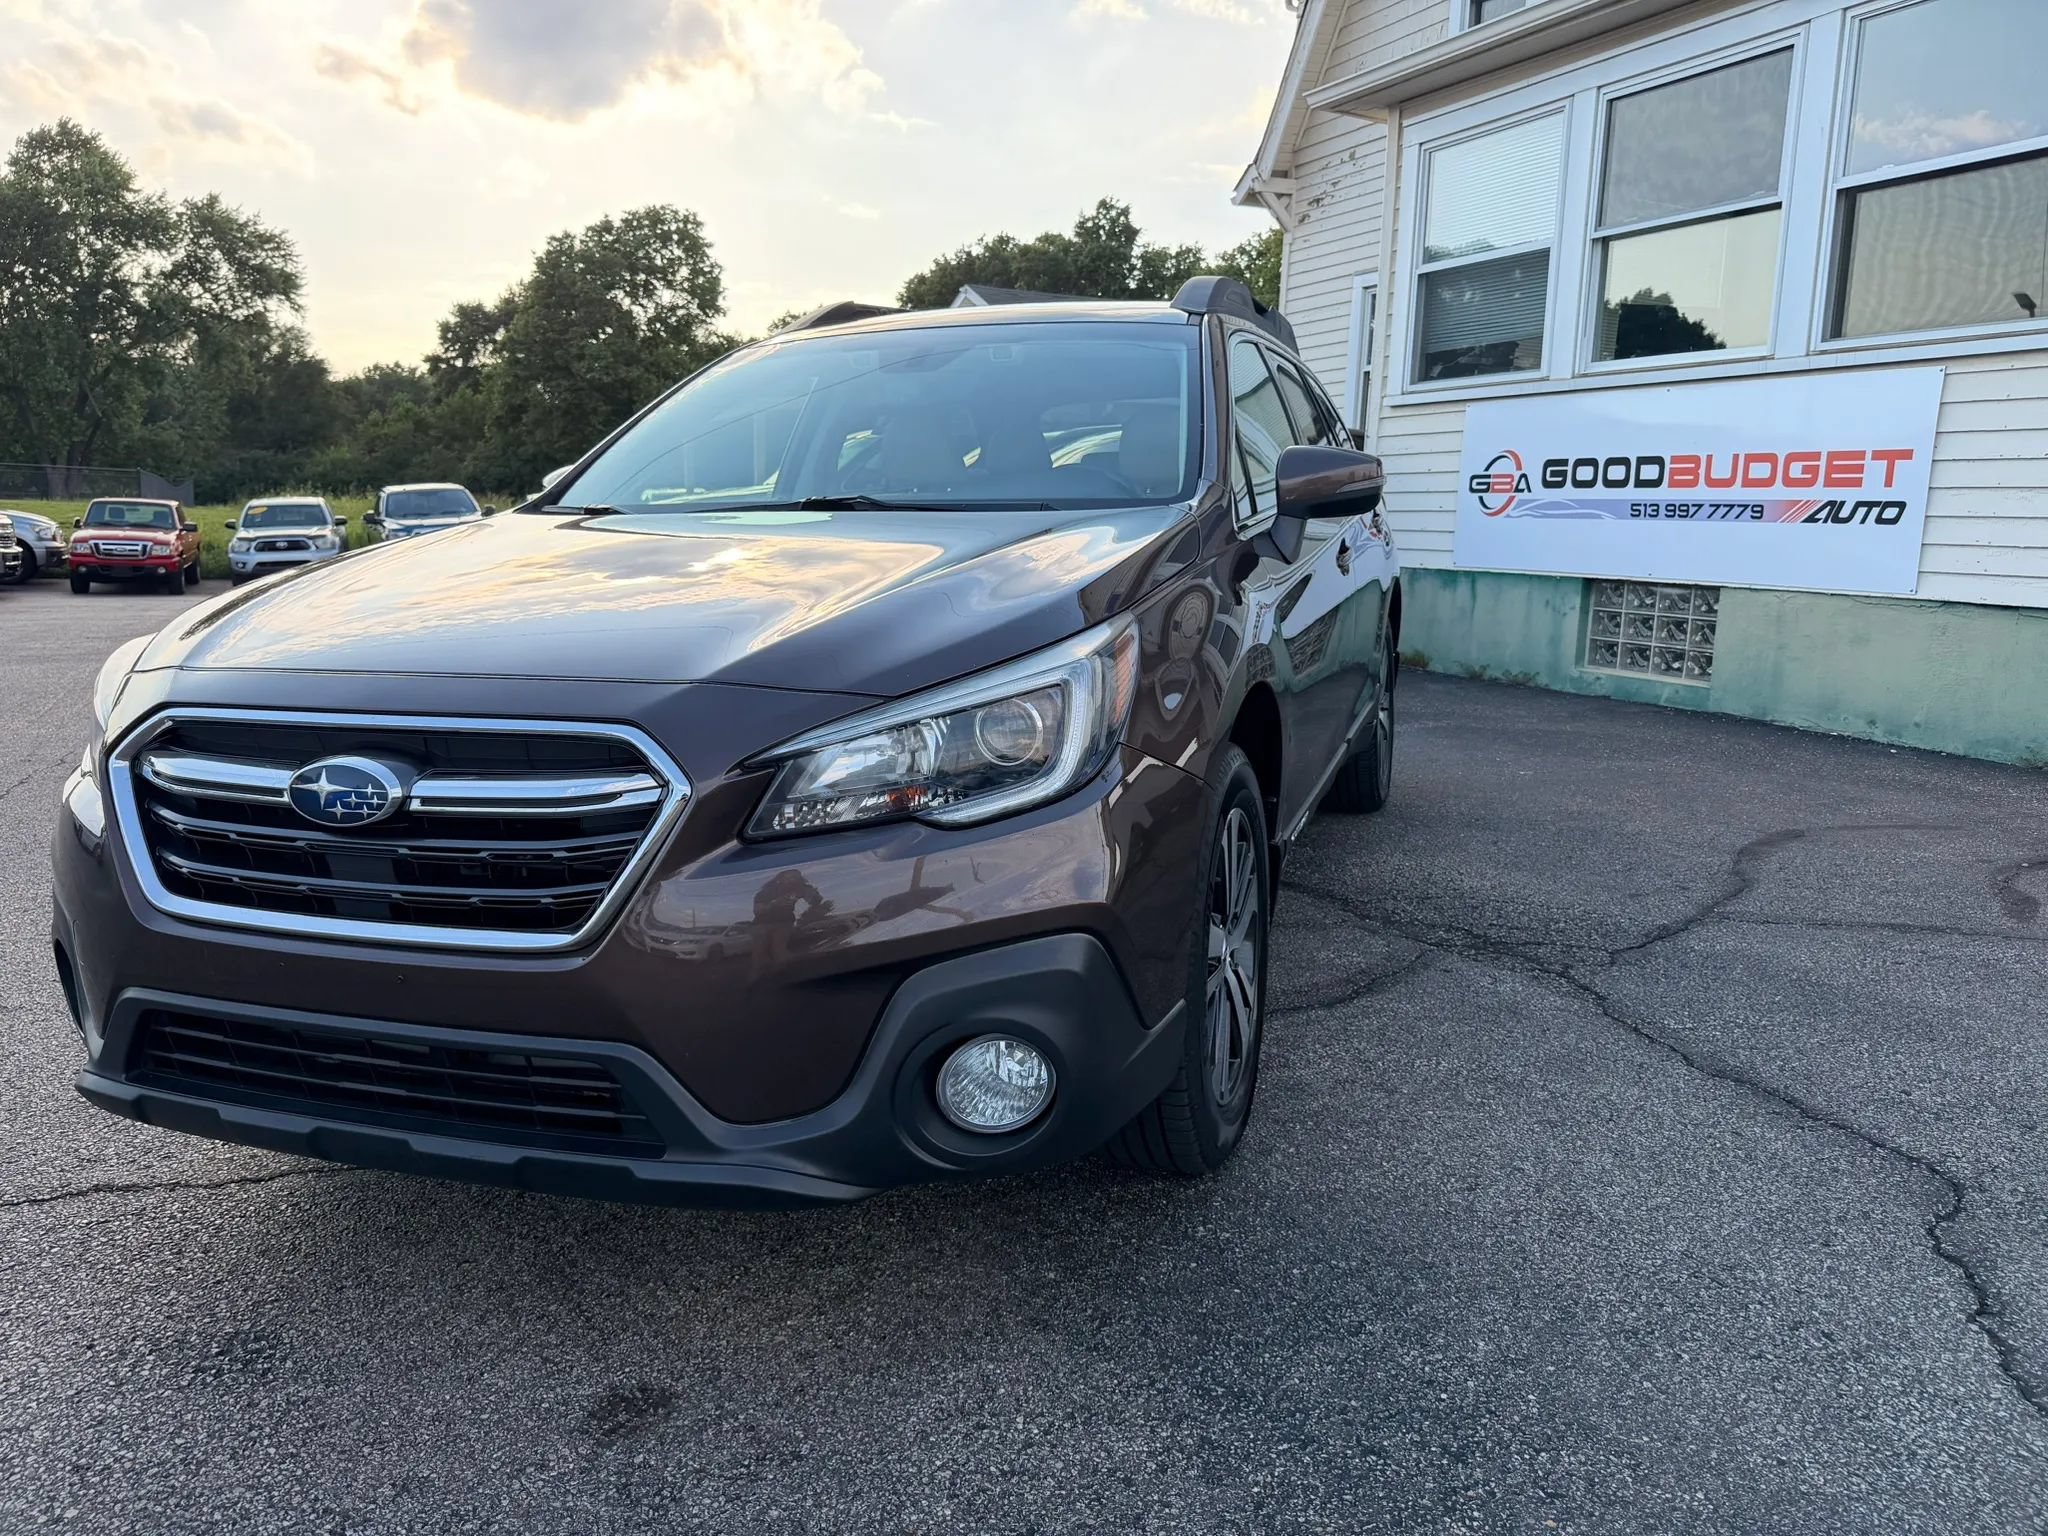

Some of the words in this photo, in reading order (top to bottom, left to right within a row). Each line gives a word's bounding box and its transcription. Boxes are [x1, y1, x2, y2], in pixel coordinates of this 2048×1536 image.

[1469, 473, 1532, 493] GBA
[1629, 503, 1660, 519] 513
[1664, 503, 1704, 519] 997
[1706, 503, 1765, 520] 7779
[1801, 500, 1908, 526] AUTO
